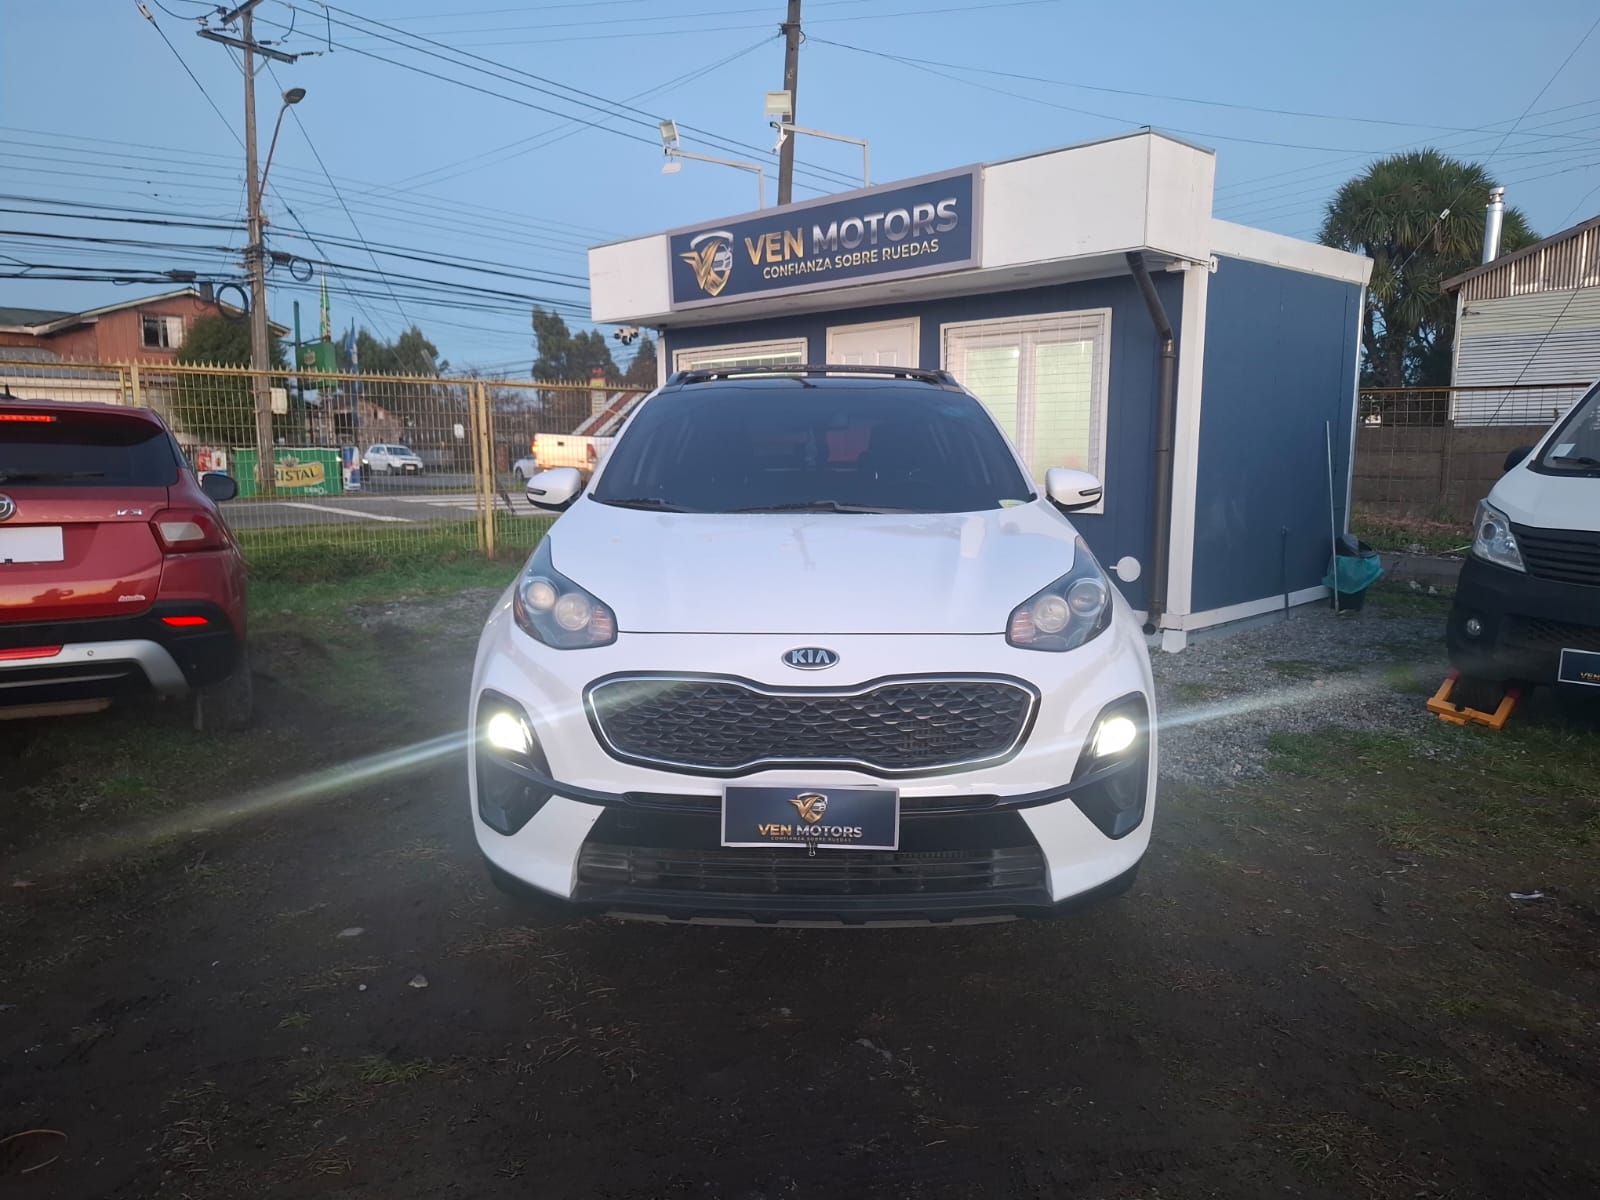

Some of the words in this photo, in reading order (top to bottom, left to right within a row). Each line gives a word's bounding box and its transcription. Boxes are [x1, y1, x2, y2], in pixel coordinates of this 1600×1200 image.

[744, 227, 804, 265] VEN
[812, 197, 958, 254] MOTORS
[763, 257, 832, 279] CONFIANZA
[835, 249, 878, 269] SOBRE
[882, 239, 939, 261] RUEDAS
[274, 467, 319, 481] RISTAL
[791, 649, 830, 664] KIA
[758, 823, 792, 836] VEN
[796, 824, 863, 838] MOTORS
